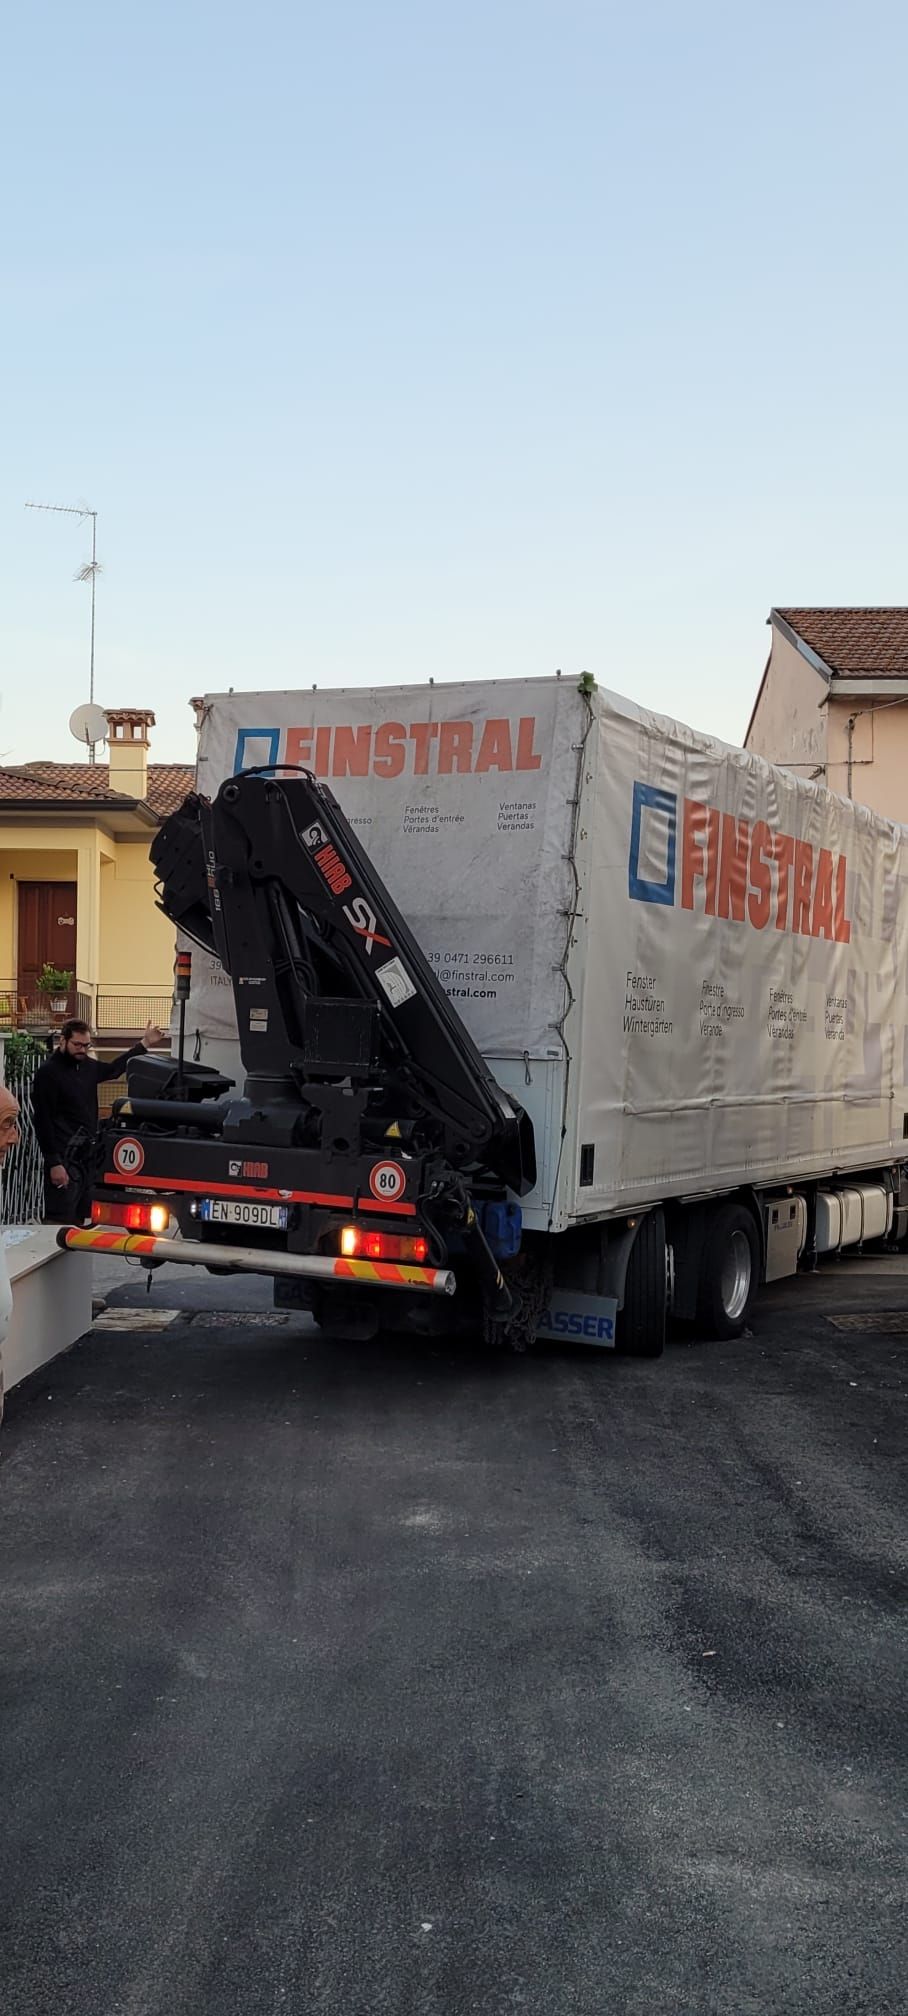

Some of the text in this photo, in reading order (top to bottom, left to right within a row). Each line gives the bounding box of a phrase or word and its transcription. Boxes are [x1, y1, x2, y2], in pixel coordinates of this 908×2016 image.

[283, 717, 542, 779] FINSTRAL
[405, 805, 440, 814] Fenêtres
[499, 802, 537, 811] Ventanas
[345, 817, 373, 825] gresso
[404, 815, 429, 824] Portes
[498, 812, 529, 821] Puertas
[497, 821, 535, 831] Verandas
[314, 843, 353, 895] HIAB
[681, 797, 852, 944] FINSTRAL
[427, 952, 515, 965] 39 0471 296611
[436, 969, 515, 982] l@finstral.com
[626, 971, 657, 990] Fenster
[445, 987, 497, 999] stral.com
[625, 993, 665, 1013] Haustüren
[623, 1016, 673, 1038] Wintergärten
[122, 1149, 136, 1164] 70
[379, 1173, 396, 1189] 80
[536, 1310, 614, 1340] ASSER
